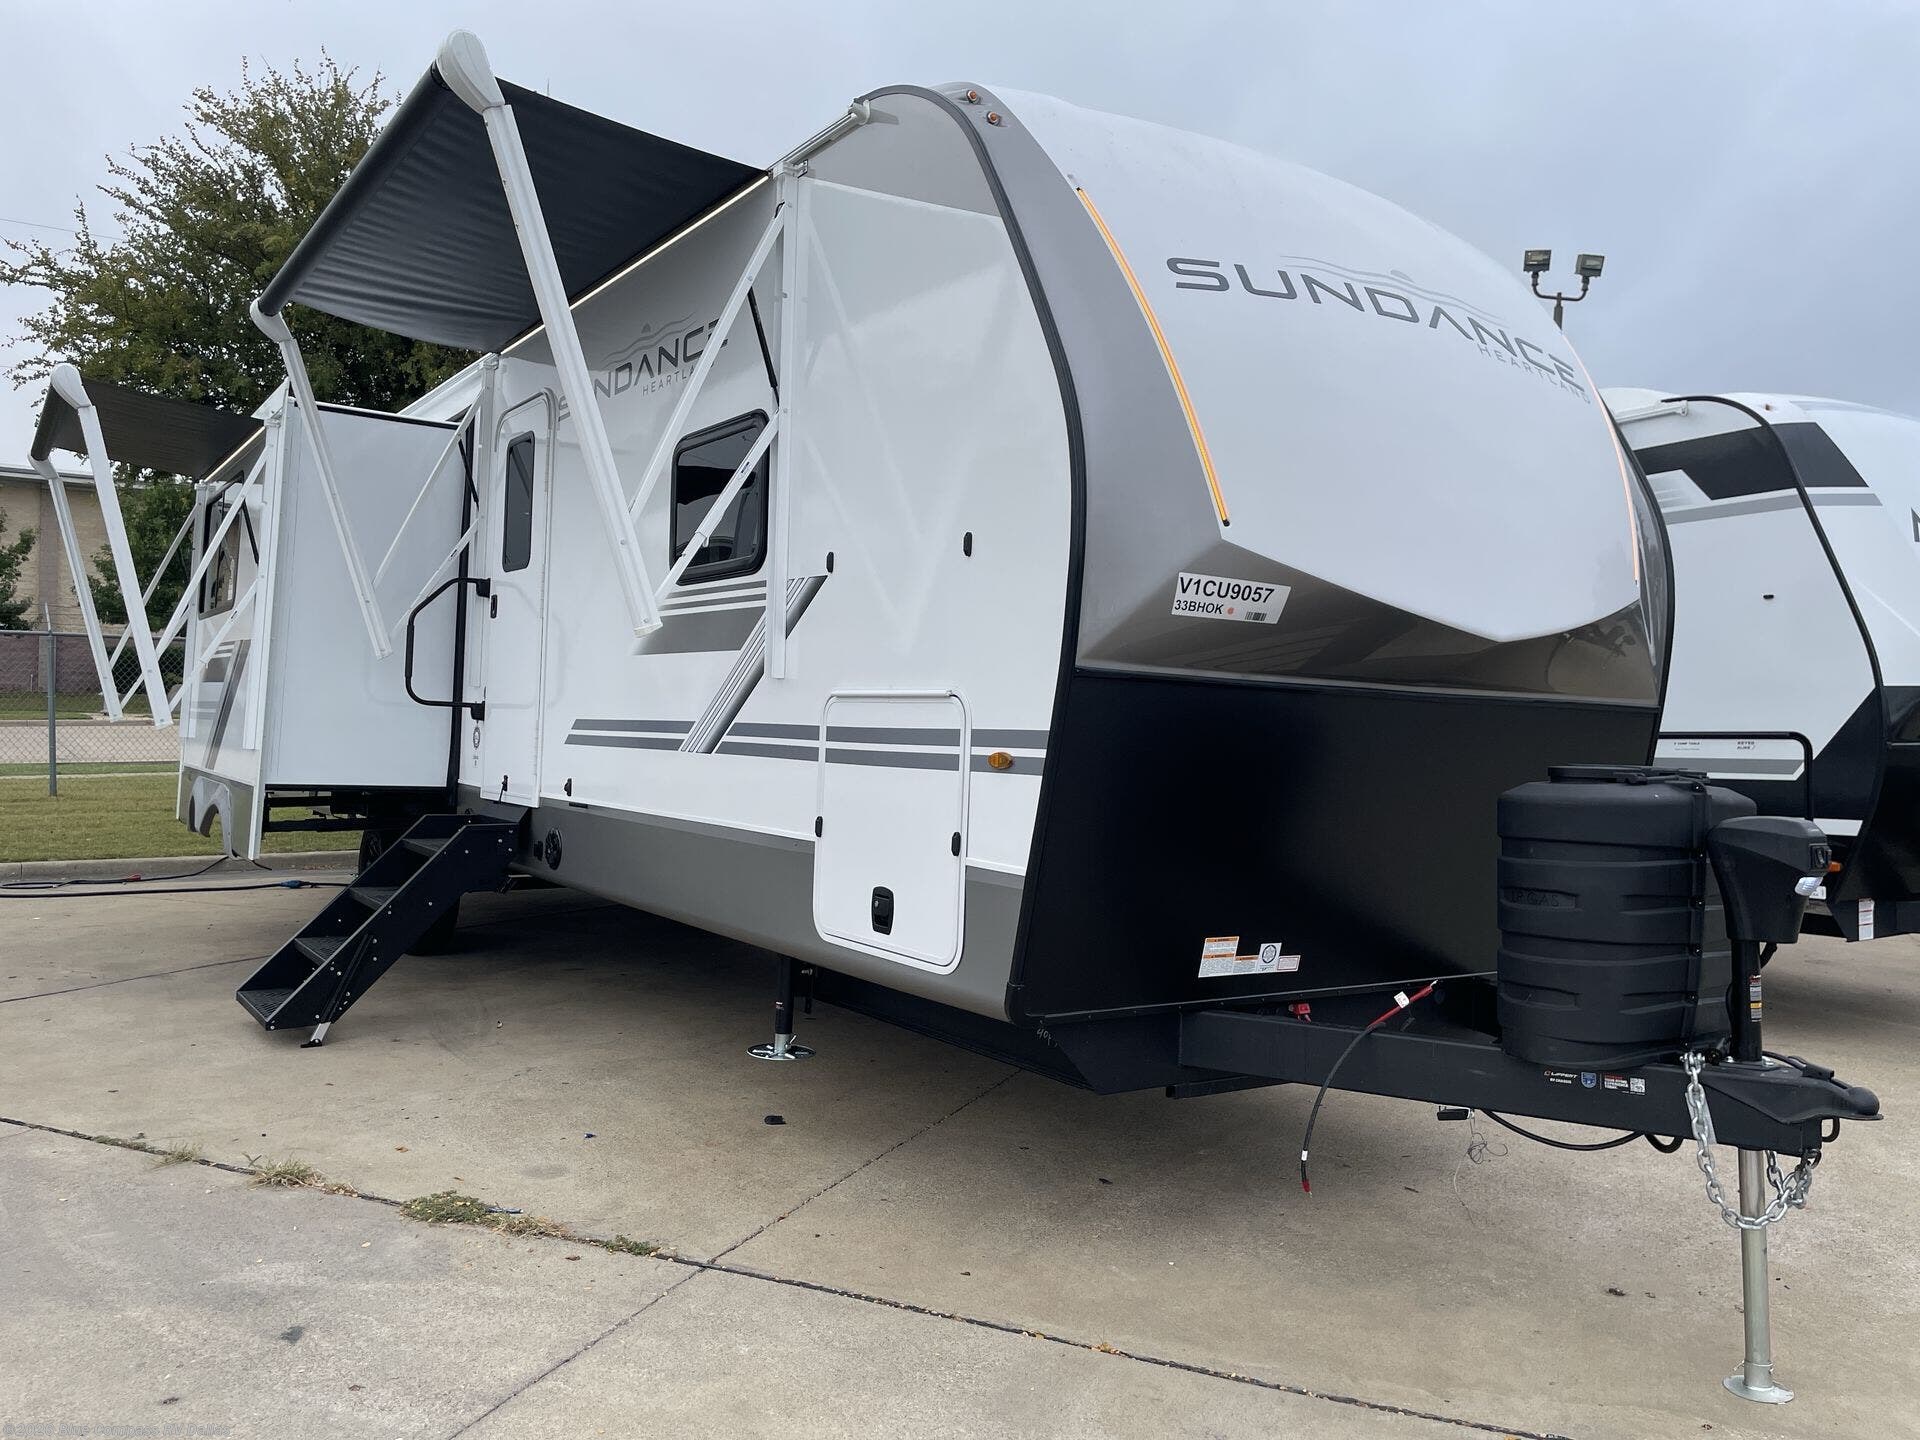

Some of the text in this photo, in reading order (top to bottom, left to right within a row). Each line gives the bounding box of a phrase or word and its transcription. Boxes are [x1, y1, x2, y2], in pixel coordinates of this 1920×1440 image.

[1166, 257, 1585, 392] SUNDANCE
[1180, 577, 1275, 603] V1CU9057
[1174, 599, 1224, 614] 33BHOK
